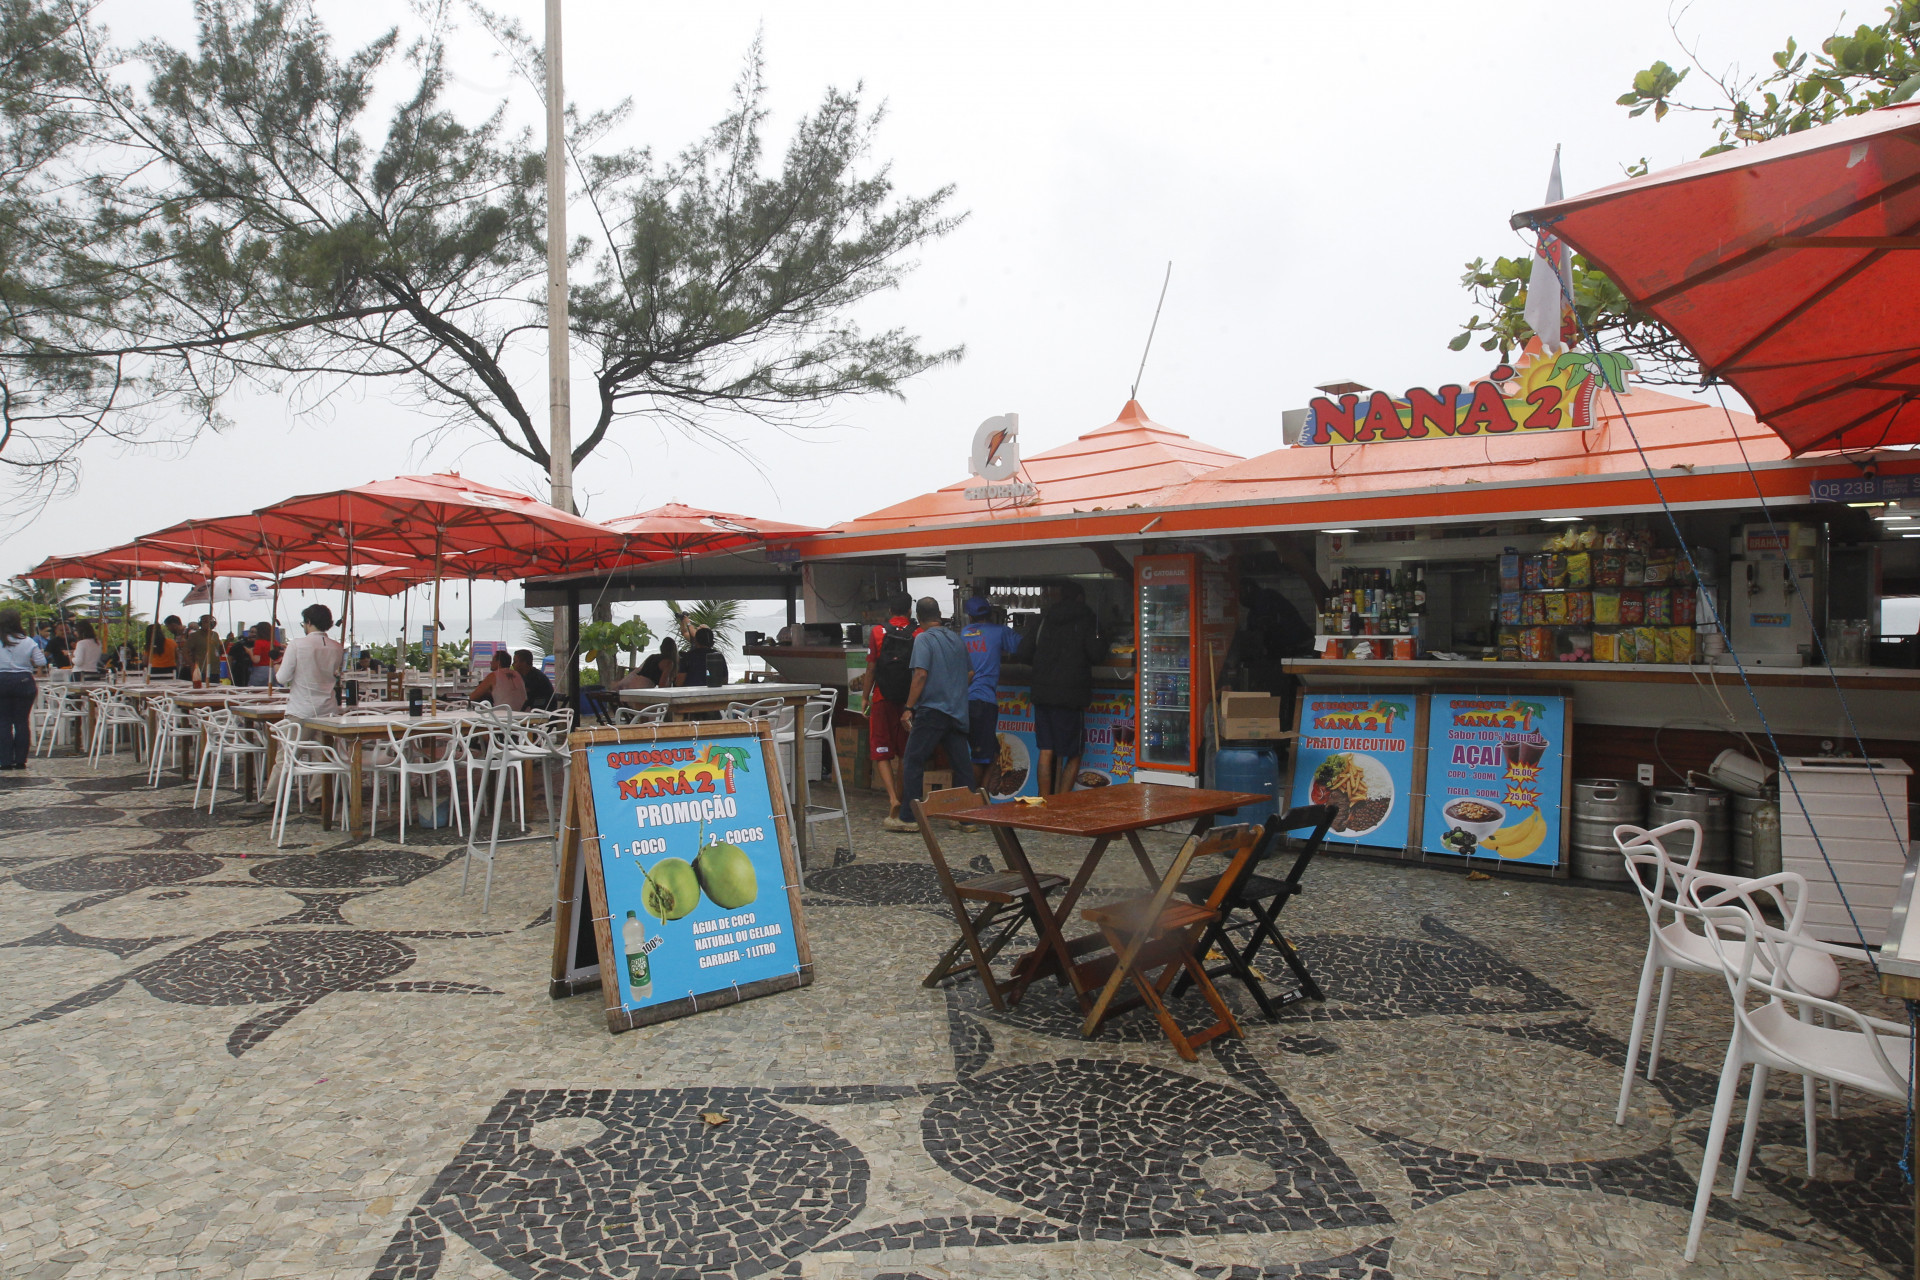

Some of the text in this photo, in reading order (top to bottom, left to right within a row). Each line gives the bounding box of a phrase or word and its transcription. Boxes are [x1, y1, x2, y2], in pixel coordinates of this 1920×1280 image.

[1309, 364, 1563, 445] NANÁ 2
[964, 483, 1036, 500] GATORADE
[1818, 484, 1840, 497] QB
[1844, 482, 1874, 495] 23B
[1749, 537, 1787, 549] BRAHMA
[1311, 701, 1369, 711] QUIOSQUE
[1449, 700, 1507, 710] QUIOSQUE
[1313, 715, 1378, 731] NANÁ 2
[1453, 714, 1516, 729] NANÁ 2
[1305, 737, 1405, 752] PRATO EXECUTIVO
[1448, 729, 1542, 743] Sabor 100% Natural
[607, 747, 696, 769] QUIOSQUE
[1452, 743, 1503, 769] AÇAÍ
[1447, 770, 1466, 779] COPO
[1472, 772, 1497, 781] 300ML
[617, 770, 715, 800] NANÁ 2
[1447, 787, 1469, 796] TIGELA
[1475, 789, 1500, 798] 500ML
[636, 795, 737, 828] PROMOÇÃO
[709, 832, 718, 847] 2
[725, 827, 764, 845] COCOS
[612, 843, 620, 858] 1
[631, 837, 666, 856] COCO
[692, 912, 756, 935] ÁGUA DE COCO
[641, 934, 664, 955] 100%
[694, 923, 782, 951] NATURAL OU GELADA
[699, 949, 740, 969] GARRAFA
[745, 947, 751, 959] 1
[751, 942, 776, 958] LITRO
